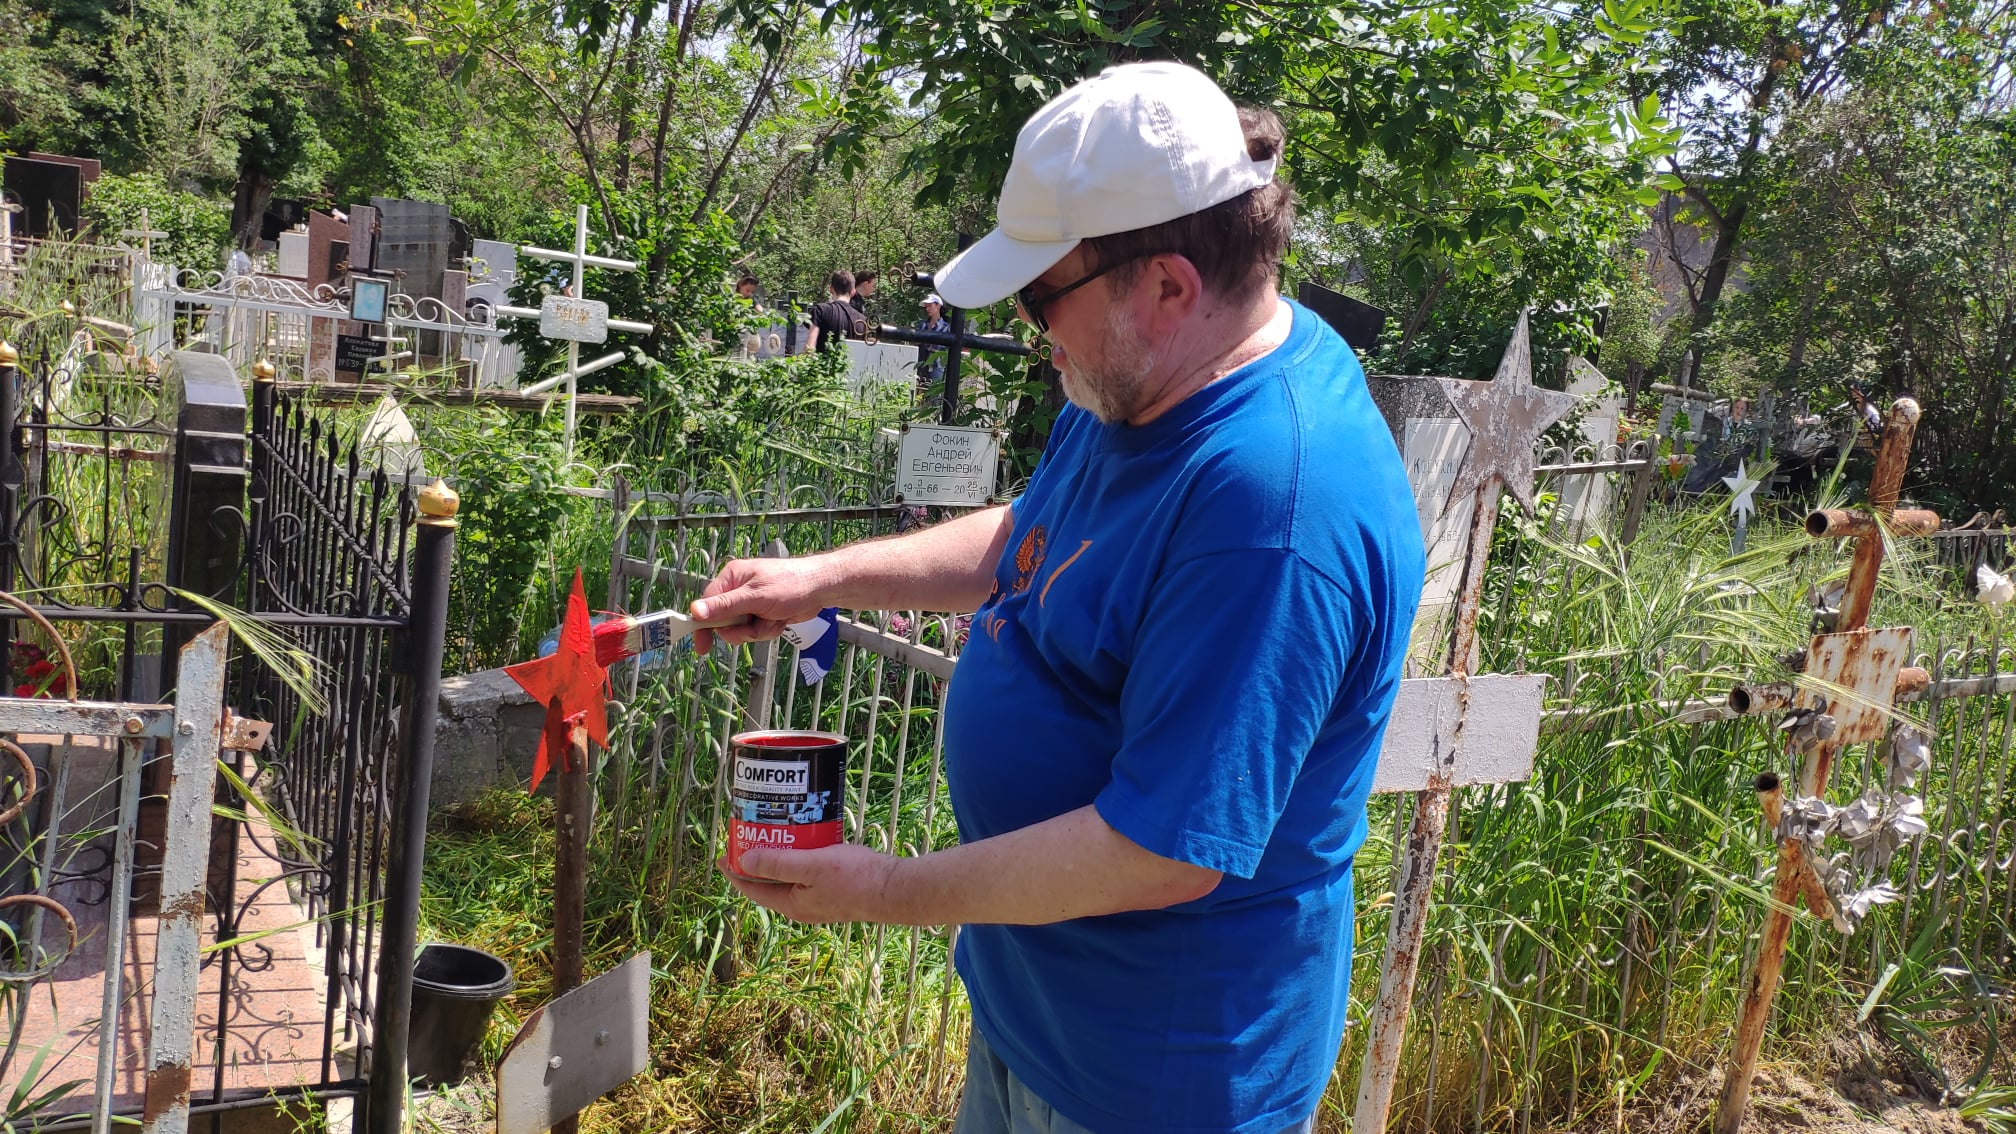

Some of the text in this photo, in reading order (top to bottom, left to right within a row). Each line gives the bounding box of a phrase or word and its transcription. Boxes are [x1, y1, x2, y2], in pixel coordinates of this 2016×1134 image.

[932, 432, 970, 446] Фокин
[927, 446, 972, 462] Андрей
[912, 458, 983, 474] Евгеньевич
[903, 482, 913, 493] 19
[926, 484, 939, 493] 66
[954, 485, 965, 495] 20
[736, 760, 806, 783] COMFORT
[736, 824, 796, 844] ЭМАЛЬ
